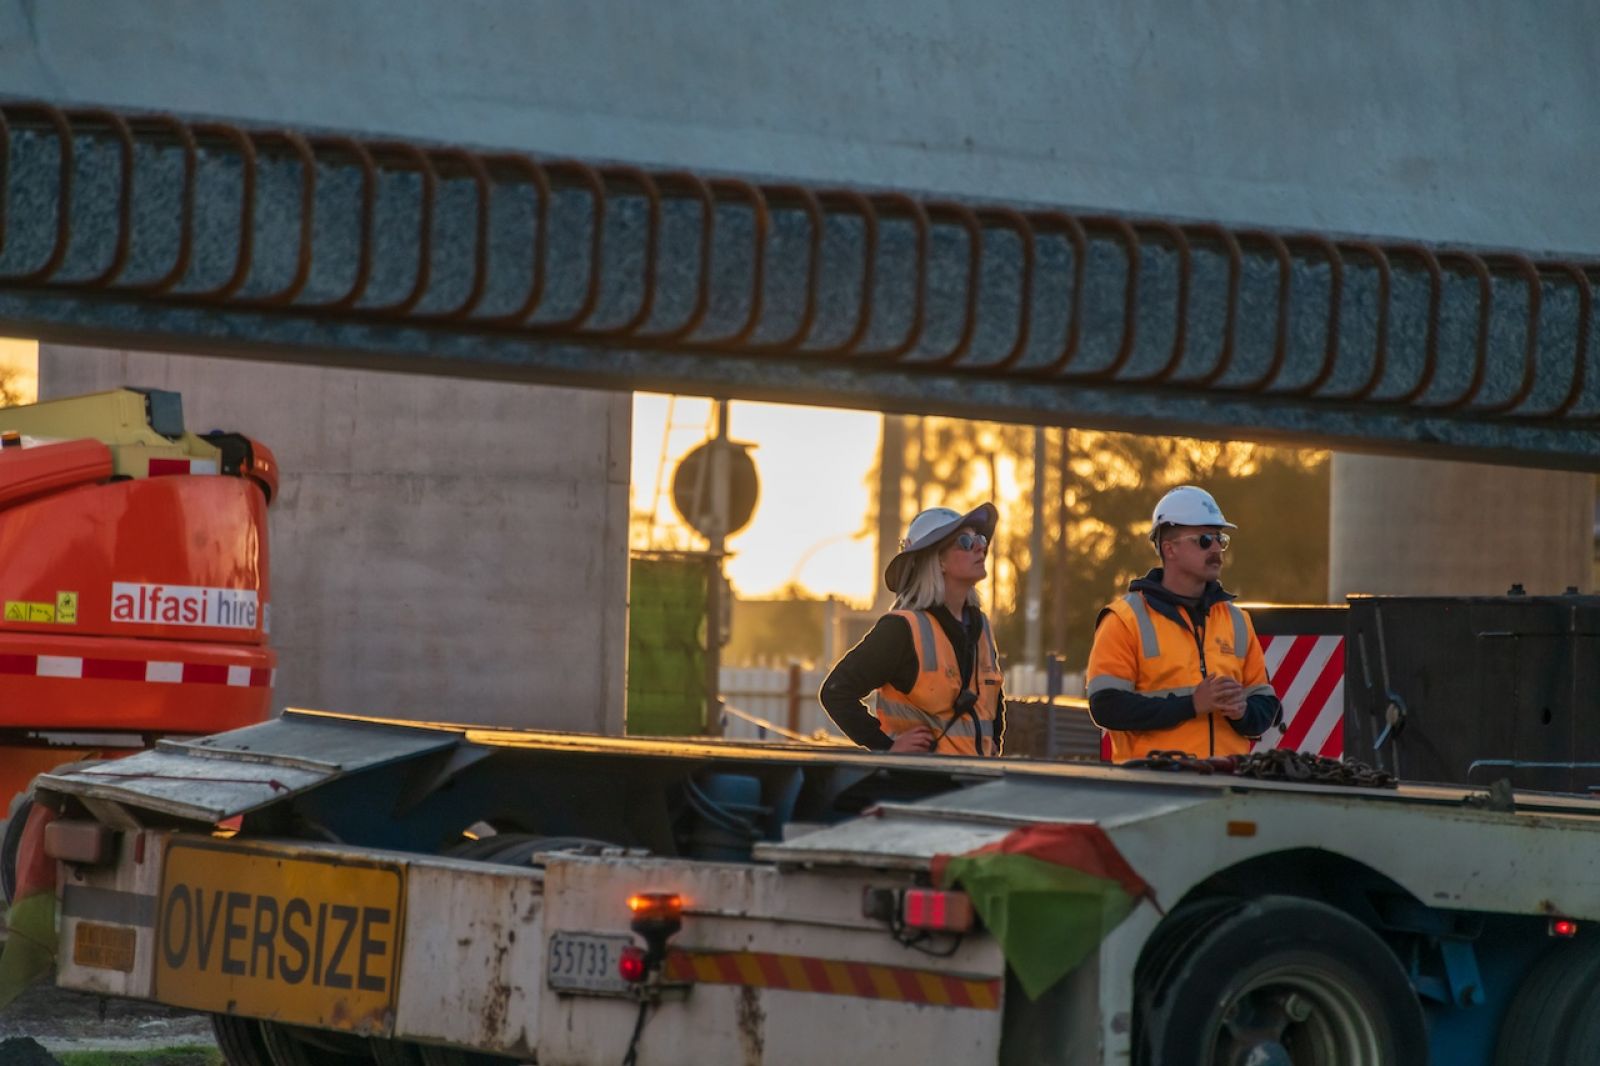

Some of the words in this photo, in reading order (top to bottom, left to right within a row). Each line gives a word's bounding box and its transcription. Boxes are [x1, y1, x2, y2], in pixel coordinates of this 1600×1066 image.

[113, 586, 208, 623] alfasi
[217, 594, 256, 627] hire
[163, 883, 391, 992] OVERSIZE
[552, 940, 626, 977] 55733-
